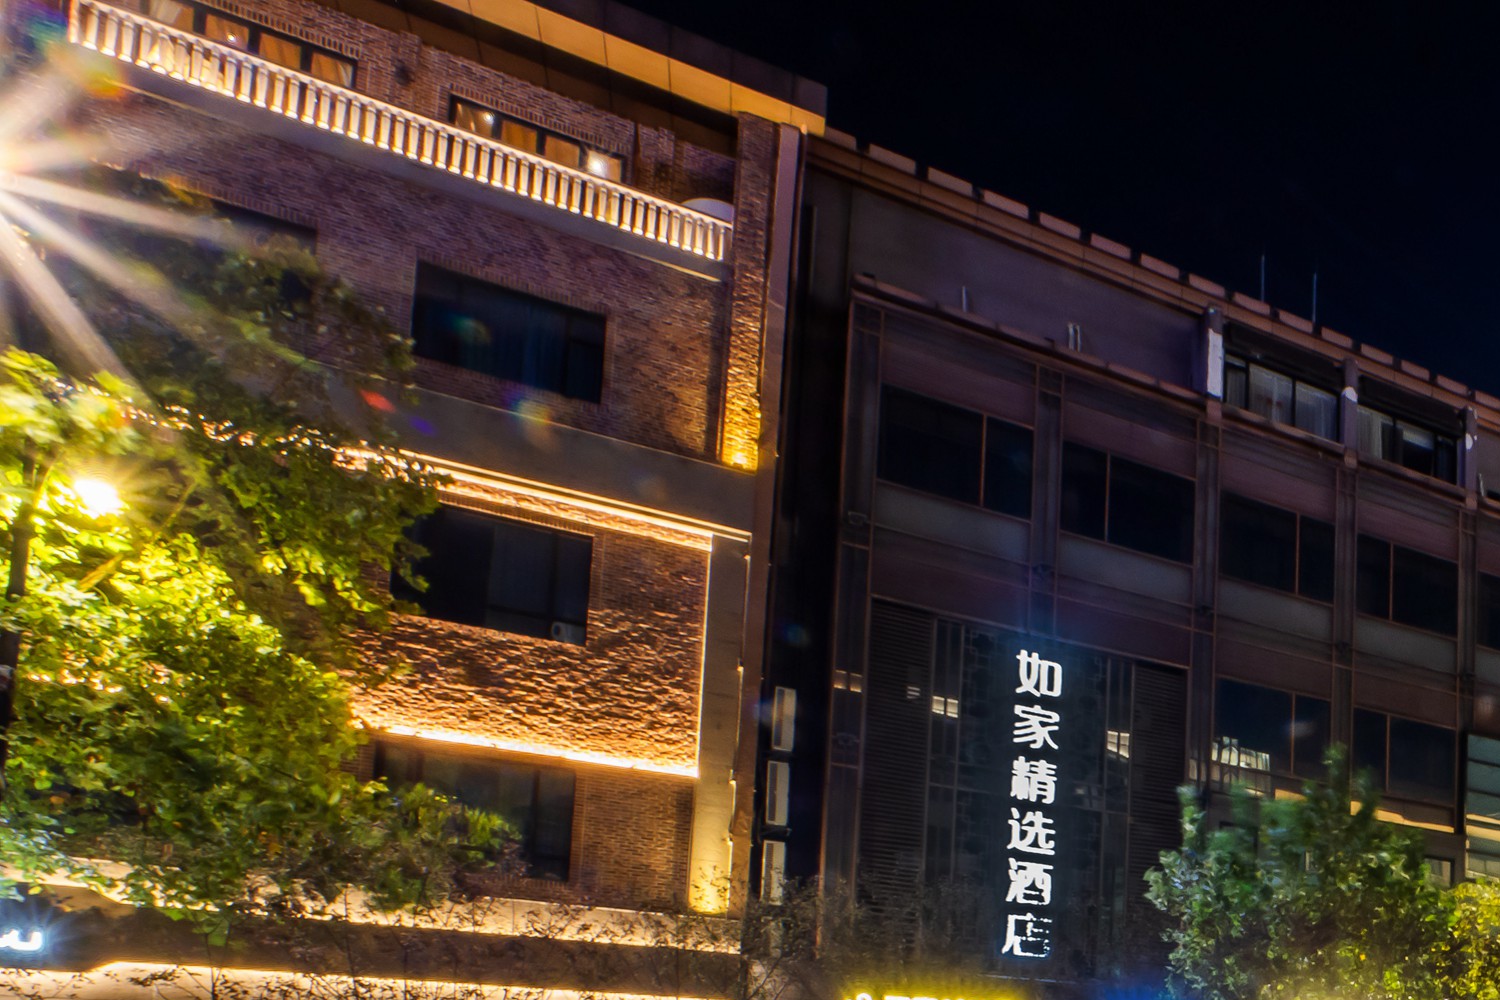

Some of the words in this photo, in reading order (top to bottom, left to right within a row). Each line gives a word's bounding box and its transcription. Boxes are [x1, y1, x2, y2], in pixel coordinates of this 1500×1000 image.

[1001, 649, 1062, 958] 如家精选酒店
